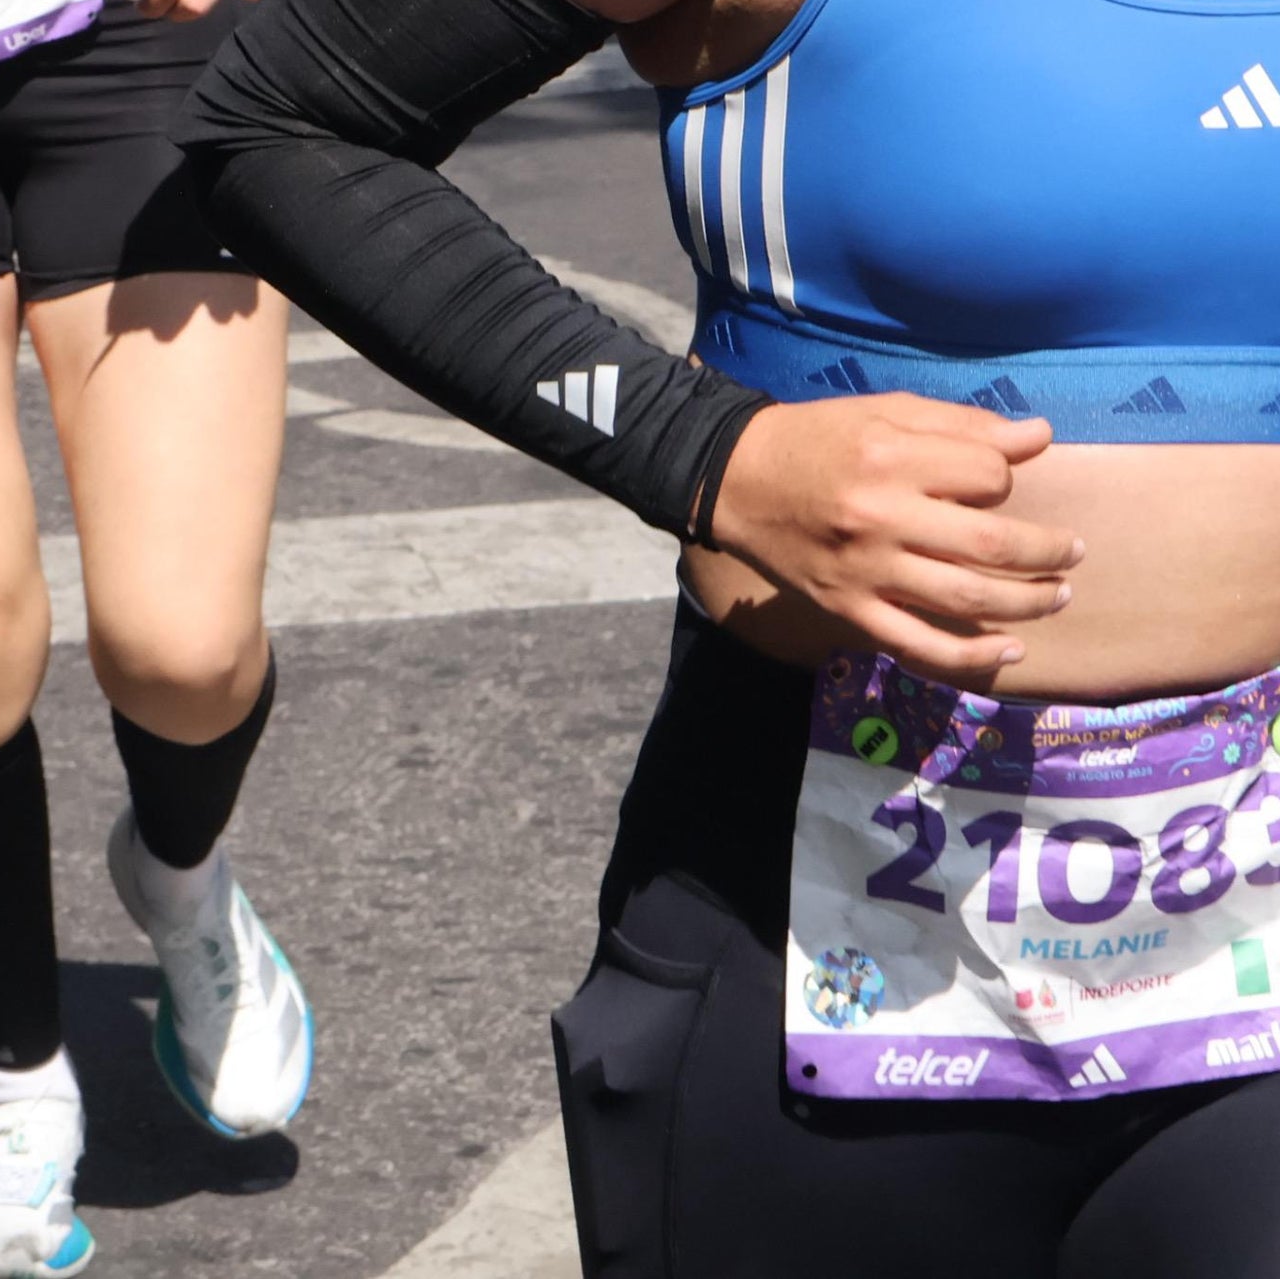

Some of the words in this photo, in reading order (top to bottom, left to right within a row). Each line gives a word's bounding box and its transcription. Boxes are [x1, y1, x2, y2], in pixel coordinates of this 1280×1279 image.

[1031, 730, 1095, 748] CIUDAD
[1078, 742, 1138, 767] telcel
[1020, 929, 1170, 961] MELANIE
[875, 1048, 989, 1086] telcel
